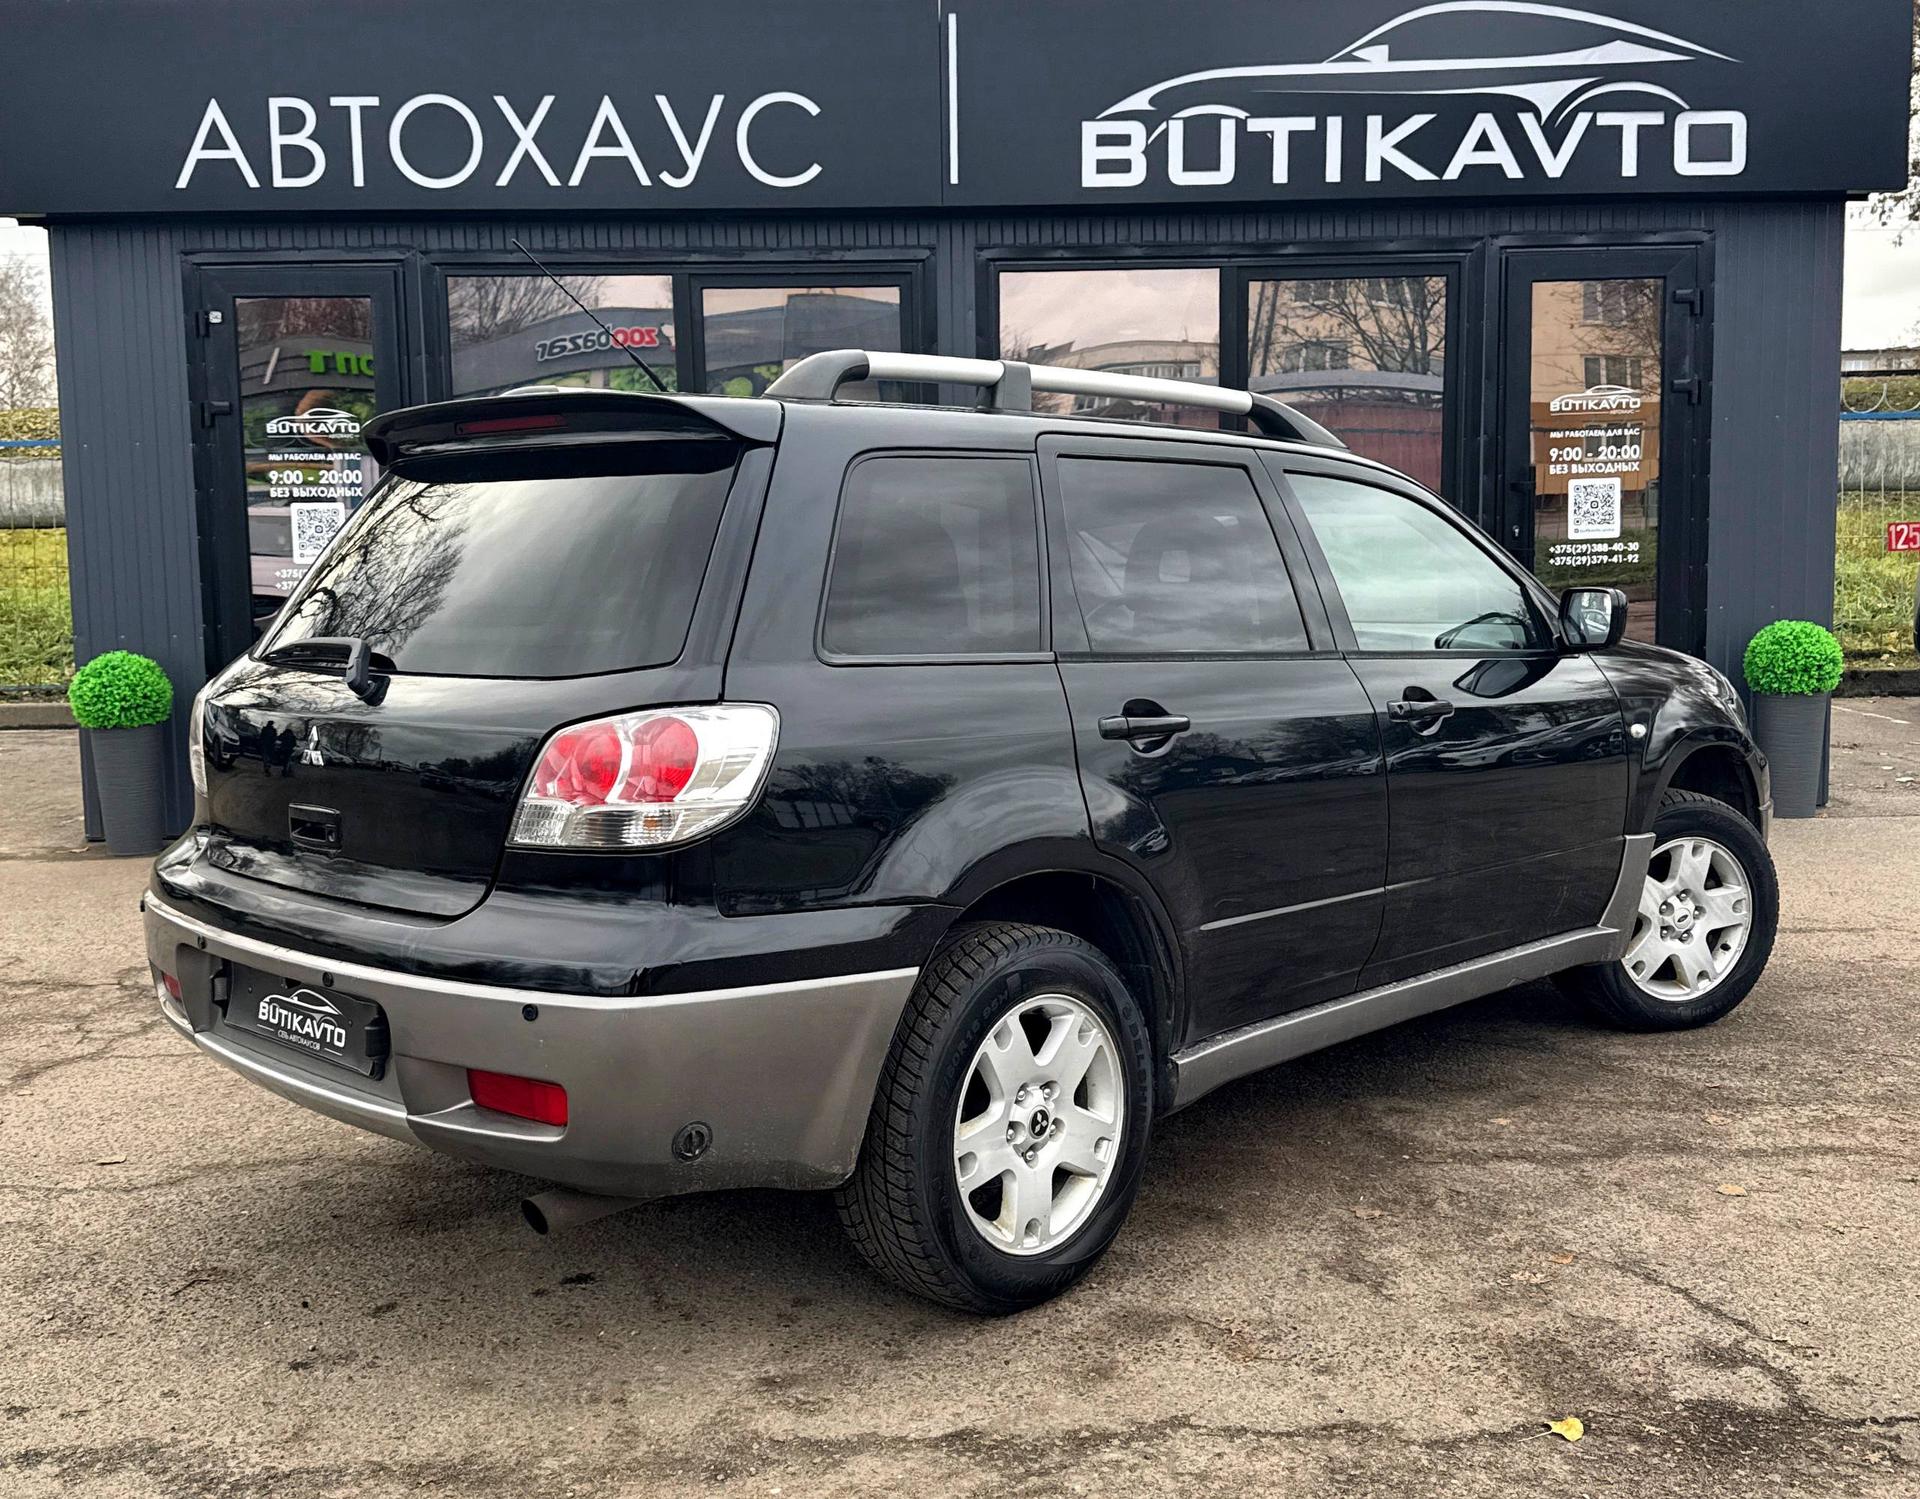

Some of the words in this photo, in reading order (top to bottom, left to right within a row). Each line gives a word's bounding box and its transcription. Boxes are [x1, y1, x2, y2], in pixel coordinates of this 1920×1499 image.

[174, 91, 824, 189] АВТОХАУС
[1081, 109, 1748, 188] BUTIKAVTO
[1549, 398, 1641, 412] BUTIKAVTO
[266, 422, 361, 434] BUTIKAVTO
[1549, 431, 1564, 439] МЫ
[1565, 430, 1605, 438] РАБОТАЕМ
[1606, 429, 1622, 437] ДЛЯ
[1624, 428, 1640, 436] ВАС
[268, 453, 282, 461] МЫ
[284, 453, 326, 461] РАБОТАЕМ
[343, 452, 361, 461] ВАС
[1549, 447, 1582, 462] 9:00
[1598, 444, 1640, 460] 20:00
[1549, 464, 1569, 475] БЕЗ
[1571, 461, 1640, 474] ВЫХОДНЫХ
[269, 470, 304, 485] 9:00
[318, 469, 363, 485] 20:00
[269, 487, 290, 498] БЕЗ
[292, 486, 363, 499] ВЫХОДНЫХ
[1549, 541, 1640, 555] +375(29)388-40-30
[1549, 554, 1640, 567] +375(29)379-41-92
[258, 1002, 346, 1048] BUTIKAVTO
